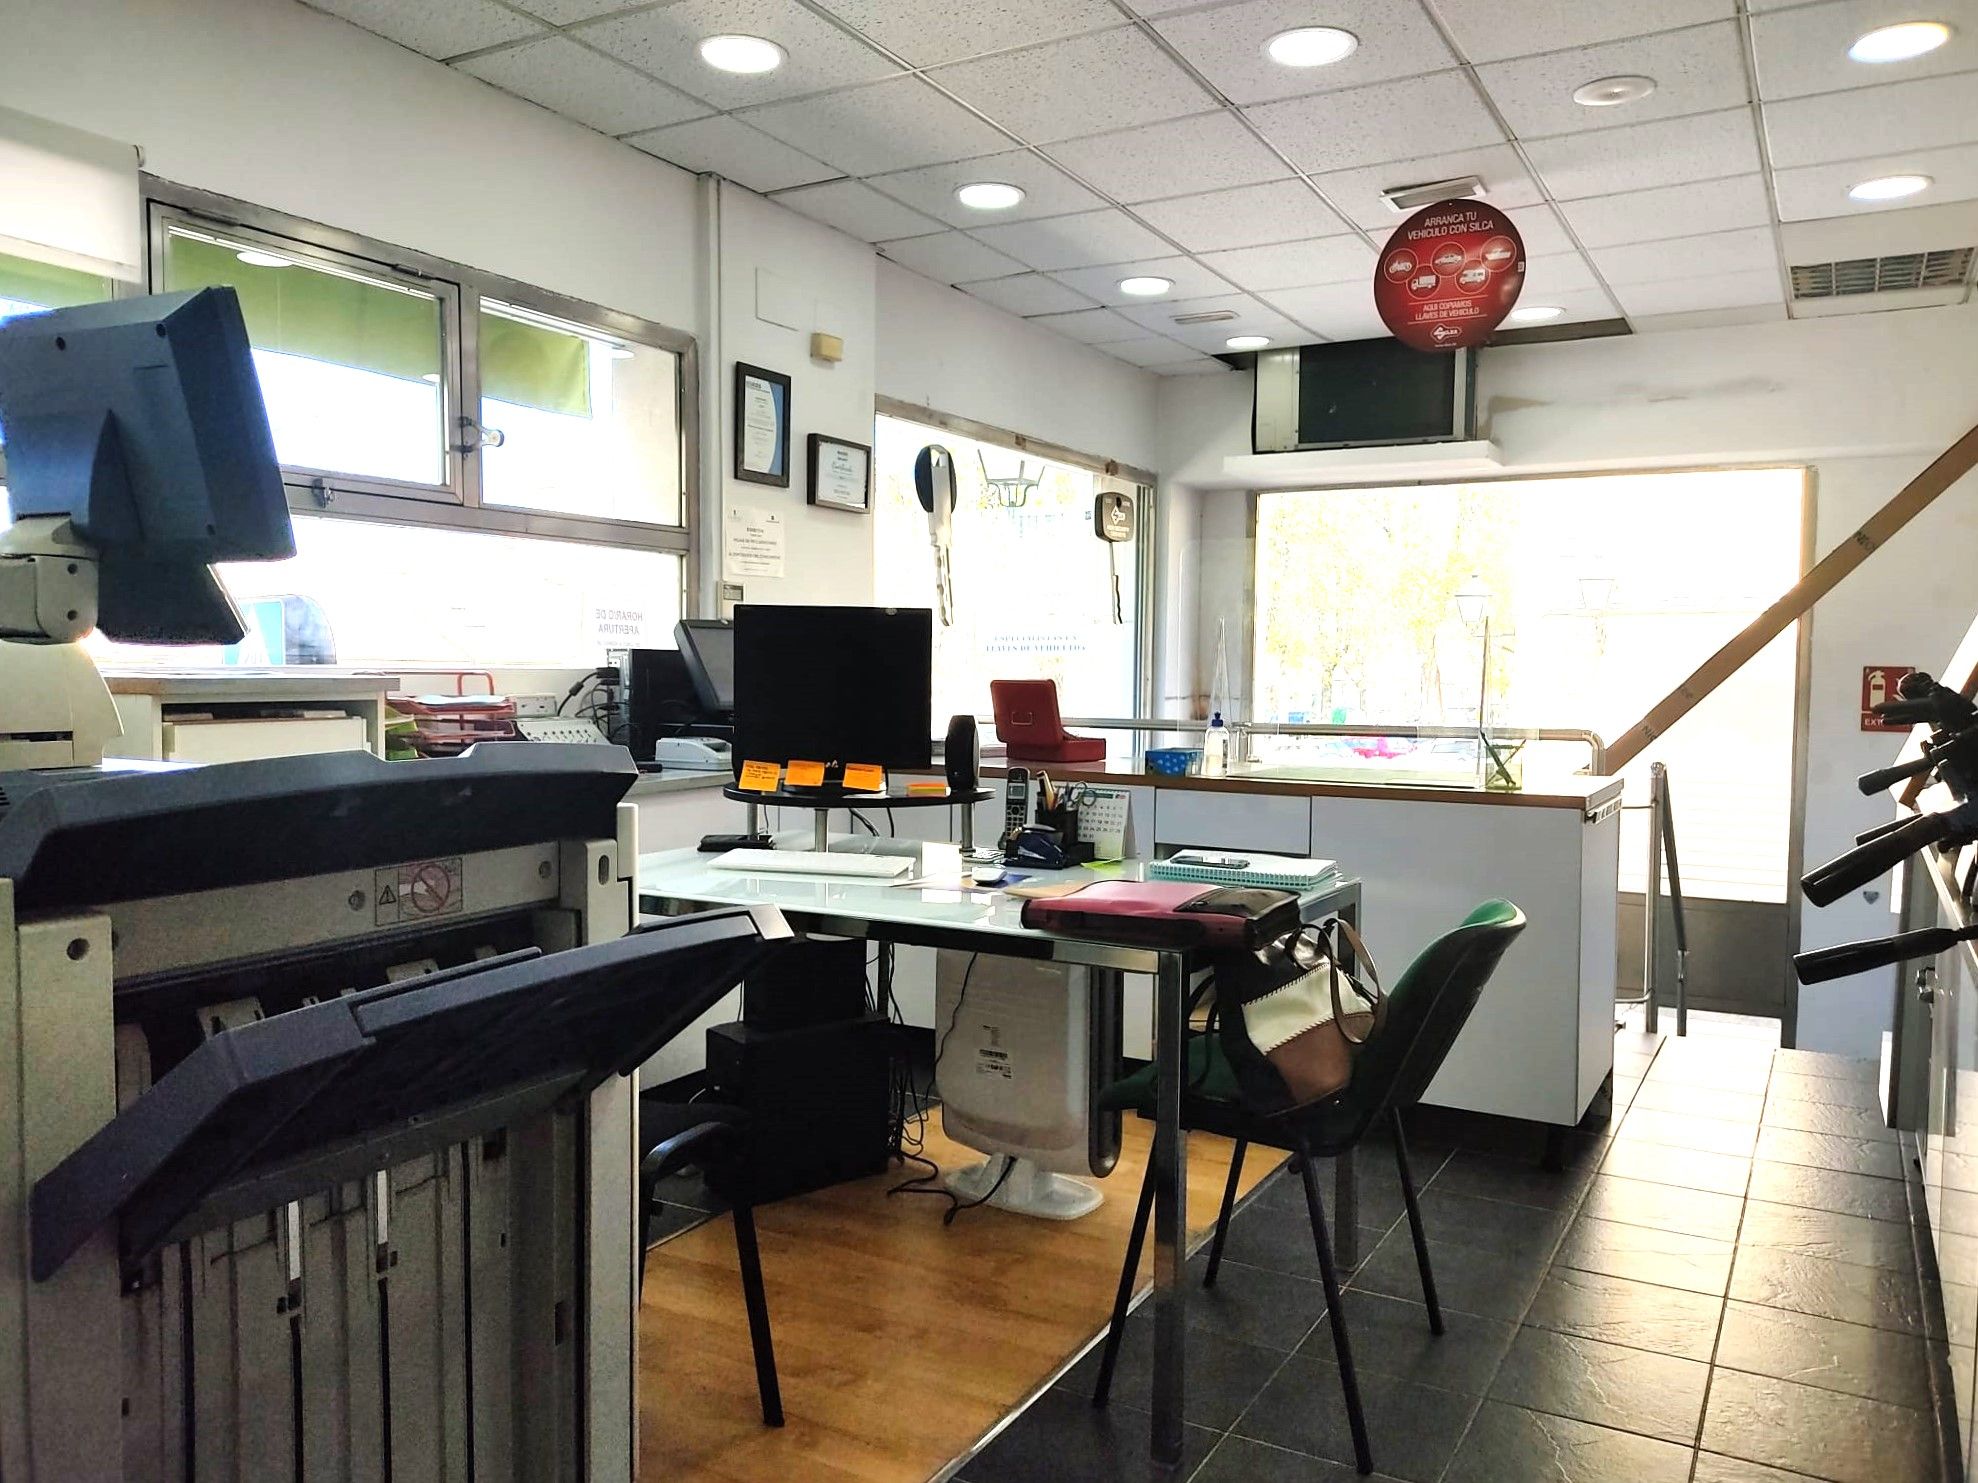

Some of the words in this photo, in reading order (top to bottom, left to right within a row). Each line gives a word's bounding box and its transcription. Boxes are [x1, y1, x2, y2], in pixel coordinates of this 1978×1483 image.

[1424, 213, 1465, 227] ARRANCA
[1466, 212, 1477, 222] TU
[1408, 227, 1447, 240] VEHICULO
[1449, 223, 1468, 235] CON
[1468, 220, 1494, 232] SILCA
[1415, 311, 1438, 321] LLAVES
[1439, 310, 1449, 318] DE
